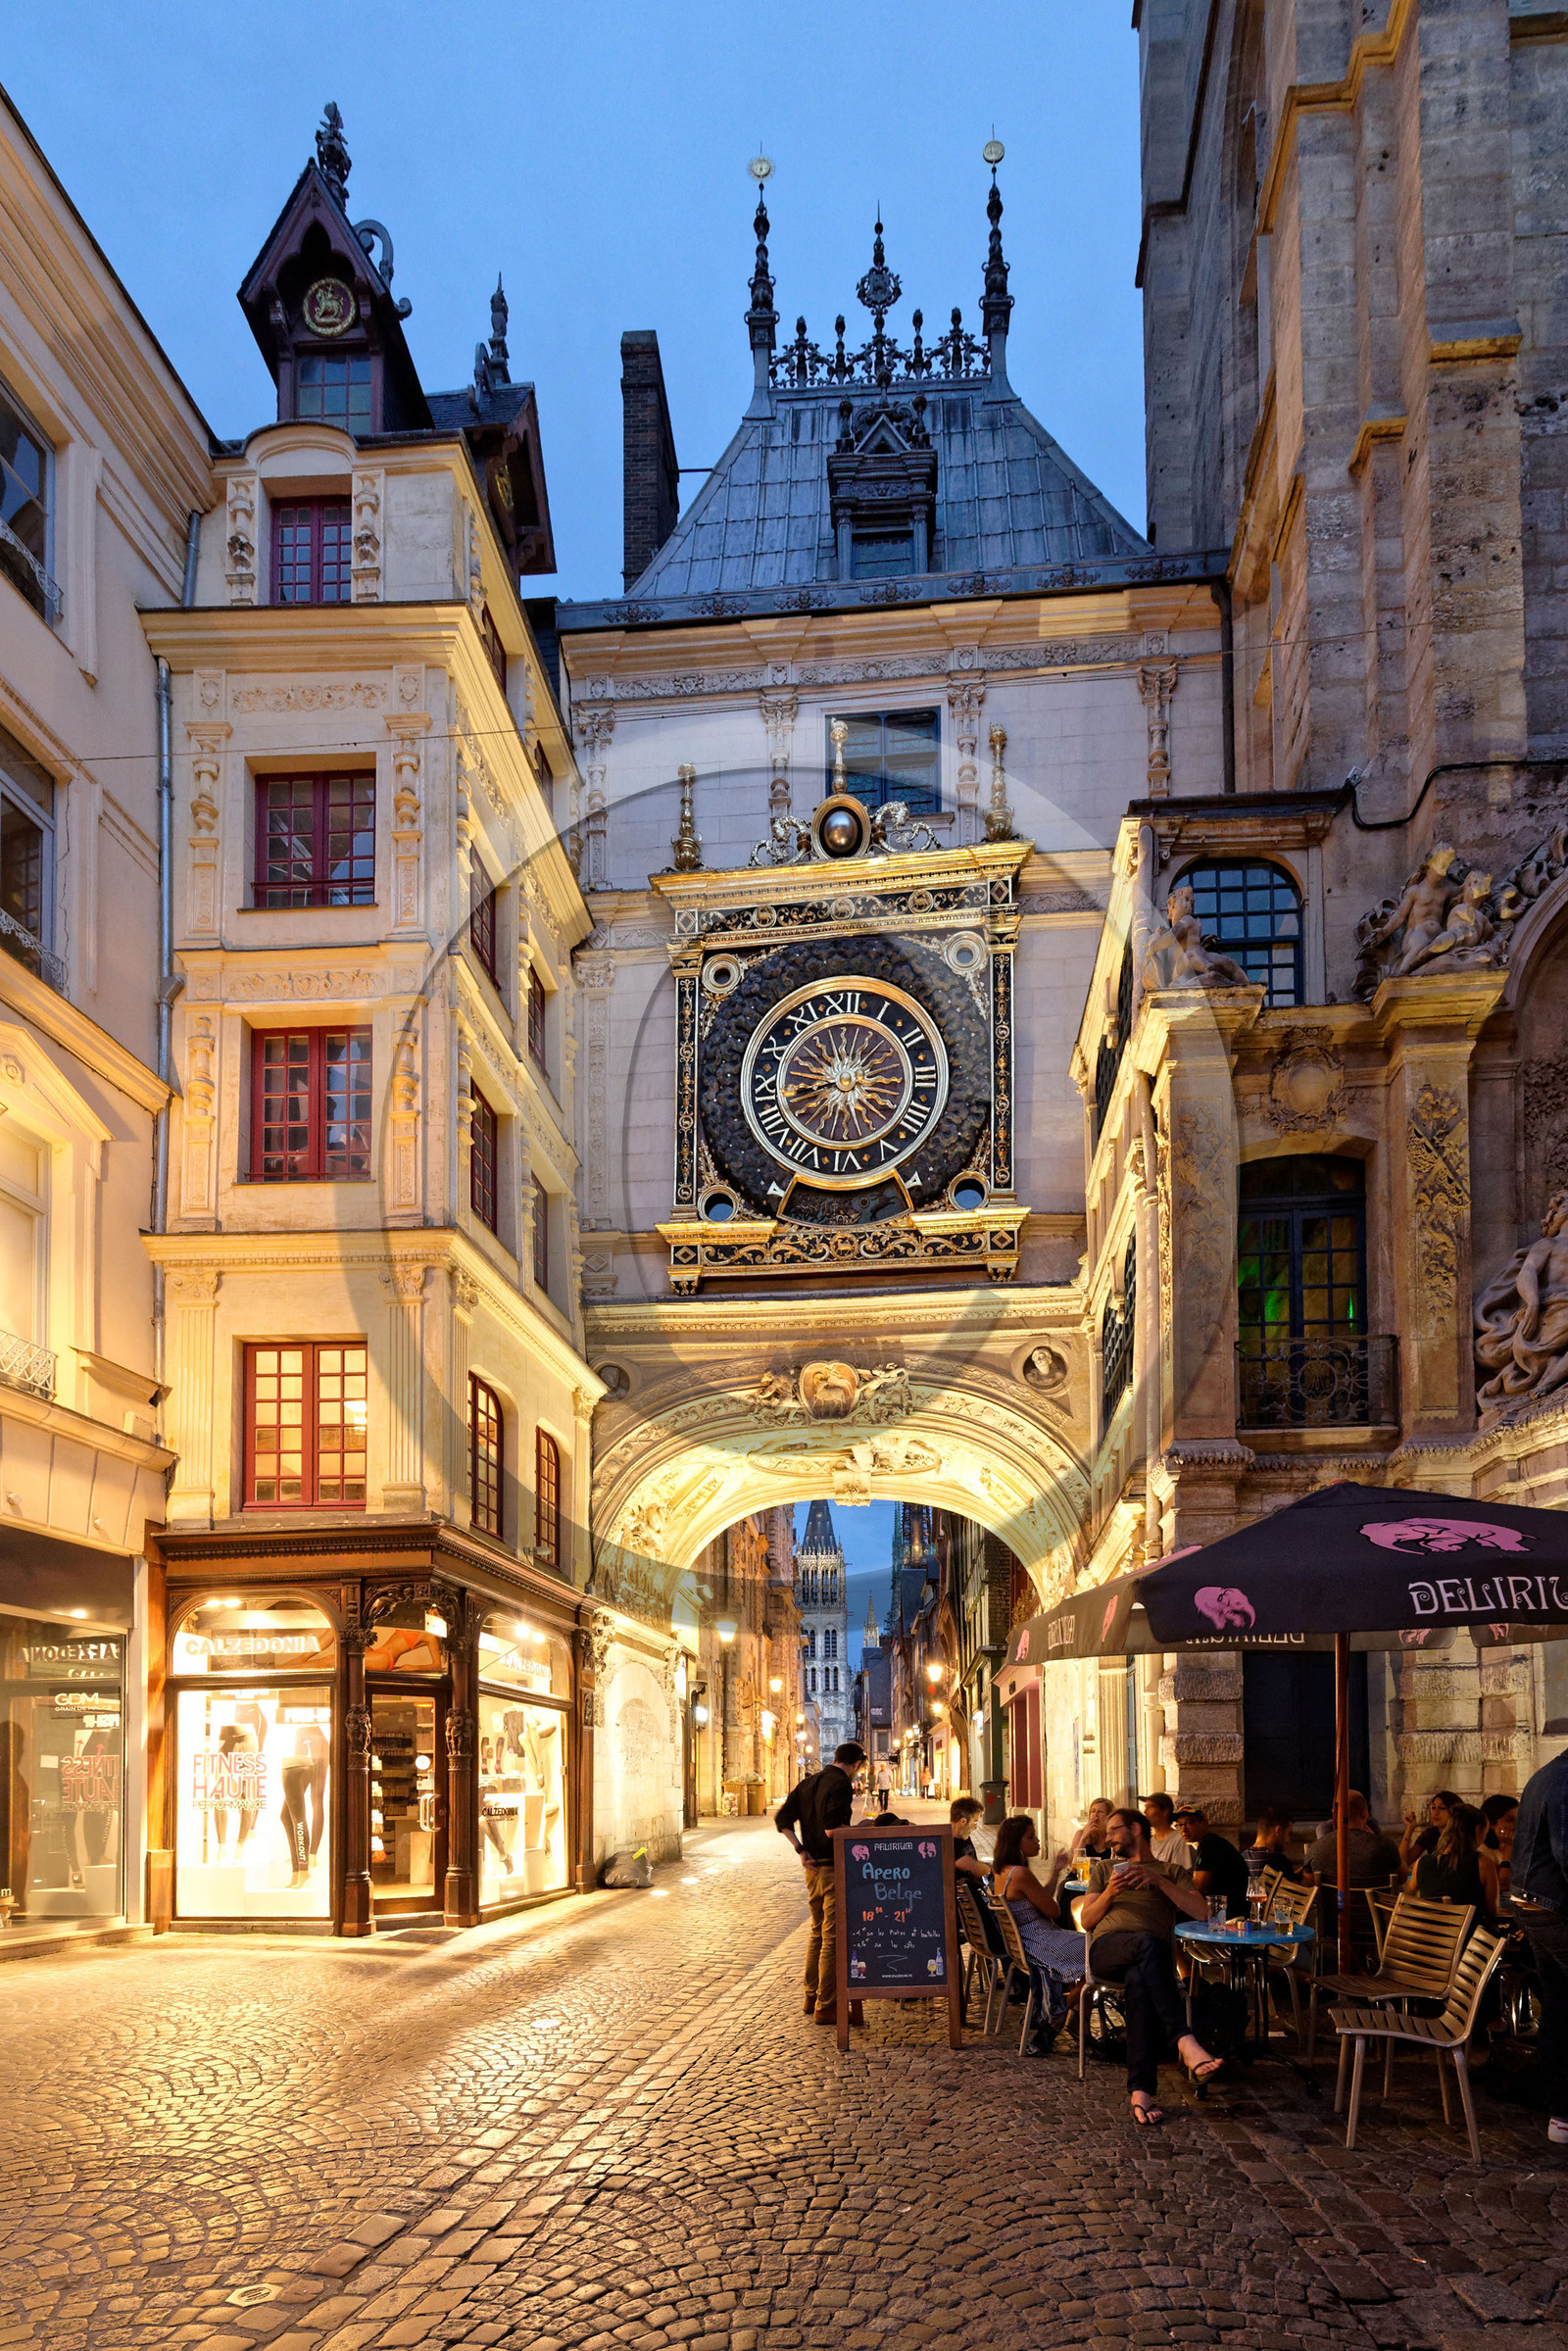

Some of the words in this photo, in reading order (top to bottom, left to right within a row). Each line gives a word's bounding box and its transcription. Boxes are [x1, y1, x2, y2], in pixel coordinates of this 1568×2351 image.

[824, 992, 861, 1015] XII
[876, 1001, 891, 1021] I
[786, 1002, 820, 1034] XI
[761, 1035, 790, 1061] X
[902, 1026, 925, 1049] II
[755, 1074, 776, 1102] IX
[914, 1065, 936, 1088] III
[759, 1104, 790, 1149] VIII
[900, 1100, 931, 1135] IIII
[787, 1137, 820, 1169] VII
[833, 1150, 862, 1172] VI
[880, 1139, 900, 1162] V
[184, 1636, 321, 1657] CALZEDONIA
[55, 1692, 99, 1706] GDM
[193, 1753, 268, 1774] FITNESS
[192, 1776, 268, 1799] HAUTE
[192, 1799, 268, 1810] PERFORMANCE
[296, 1822, 309, 1862] WORKOUT
[874, 1842, 913, 1851] DELIRIUM
